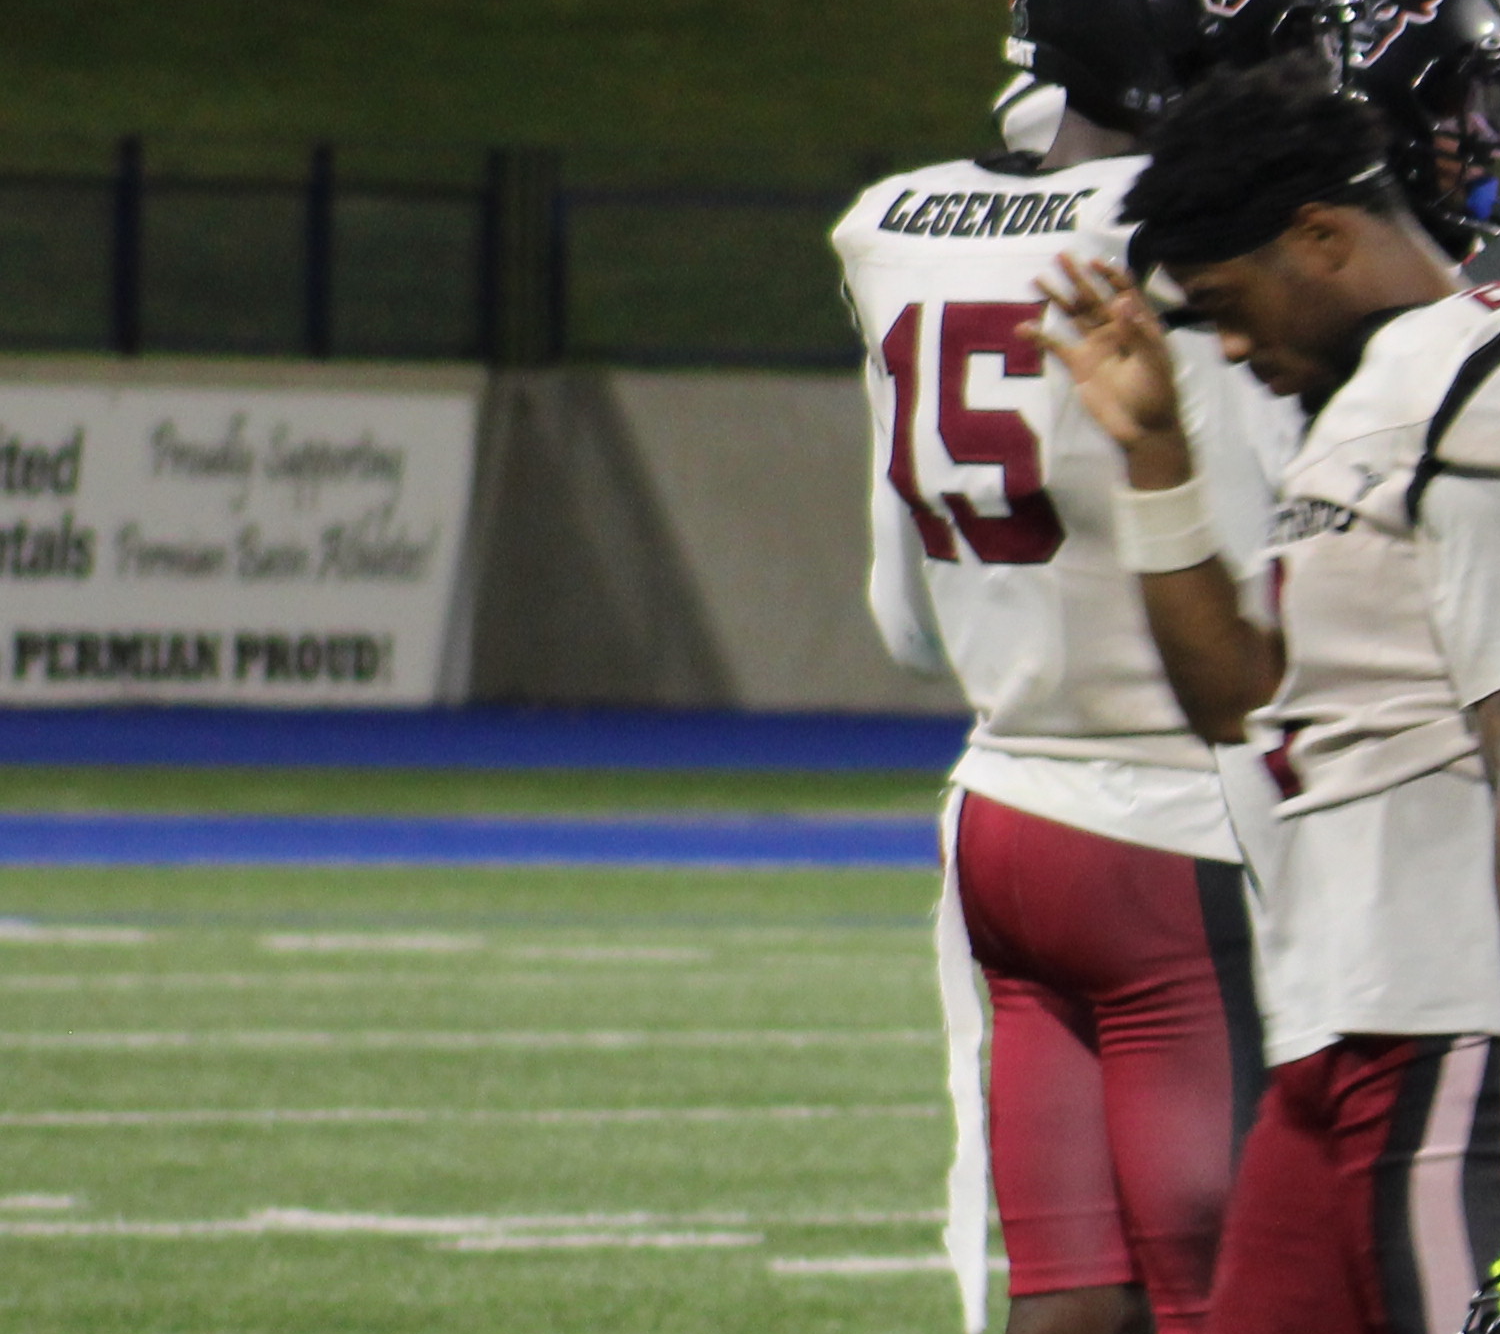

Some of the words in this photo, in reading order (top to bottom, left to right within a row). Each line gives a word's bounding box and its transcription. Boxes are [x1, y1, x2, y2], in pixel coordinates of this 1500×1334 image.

[878, 187, 1098, 238] LEGENDRE
[0, 424, 84, 497] ted
[881, 301, 1066, 565] 15
[13, 631, 221, 682] PERMIAN
